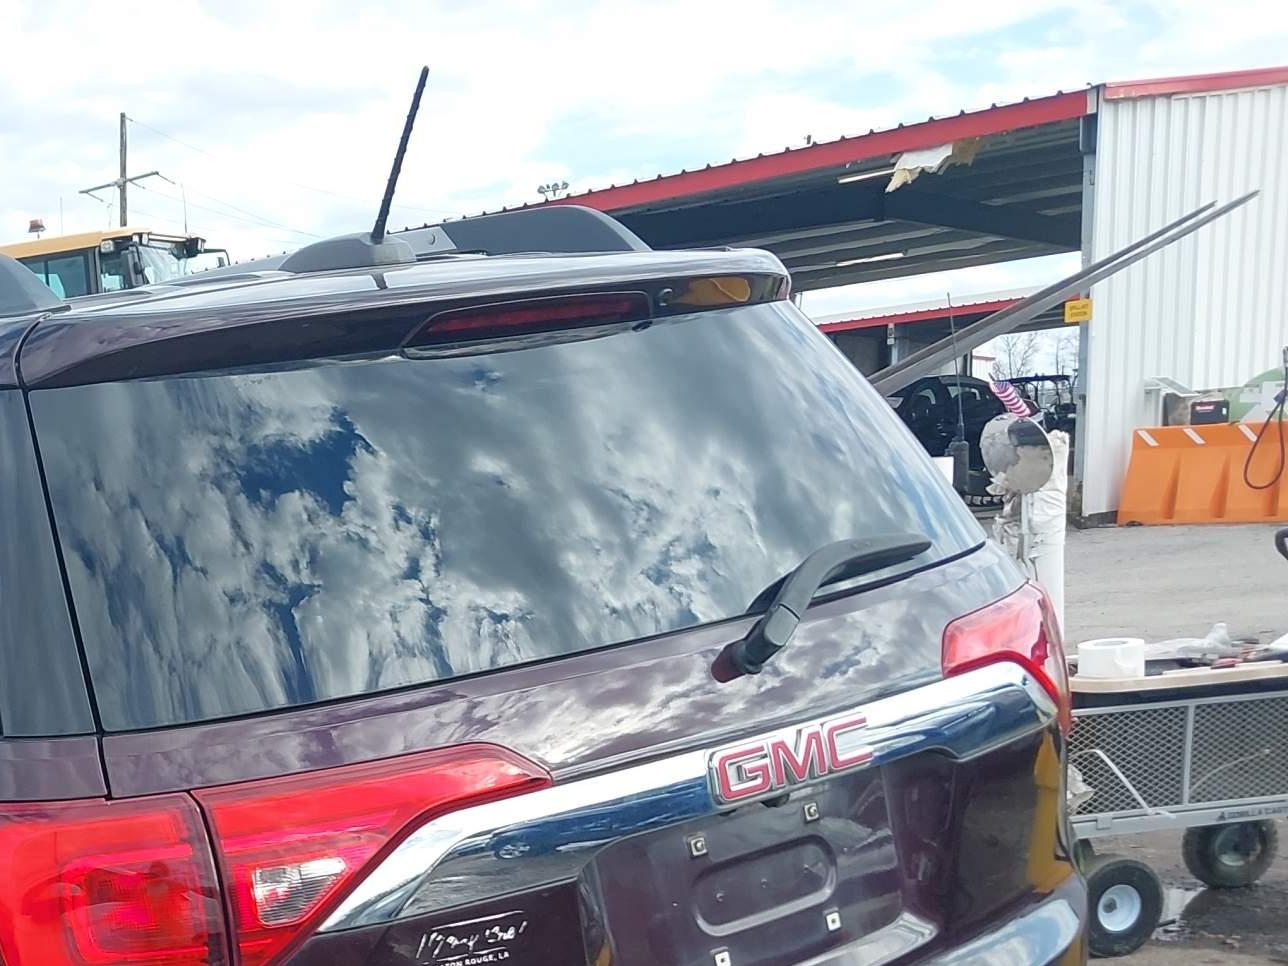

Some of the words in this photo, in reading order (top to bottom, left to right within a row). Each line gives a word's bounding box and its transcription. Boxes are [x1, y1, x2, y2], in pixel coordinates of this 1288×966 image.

[715, 712, 874, 800] GMC
[464, 954, 498, 966] ROUGE,
[498, 950, 510, 960] LA
